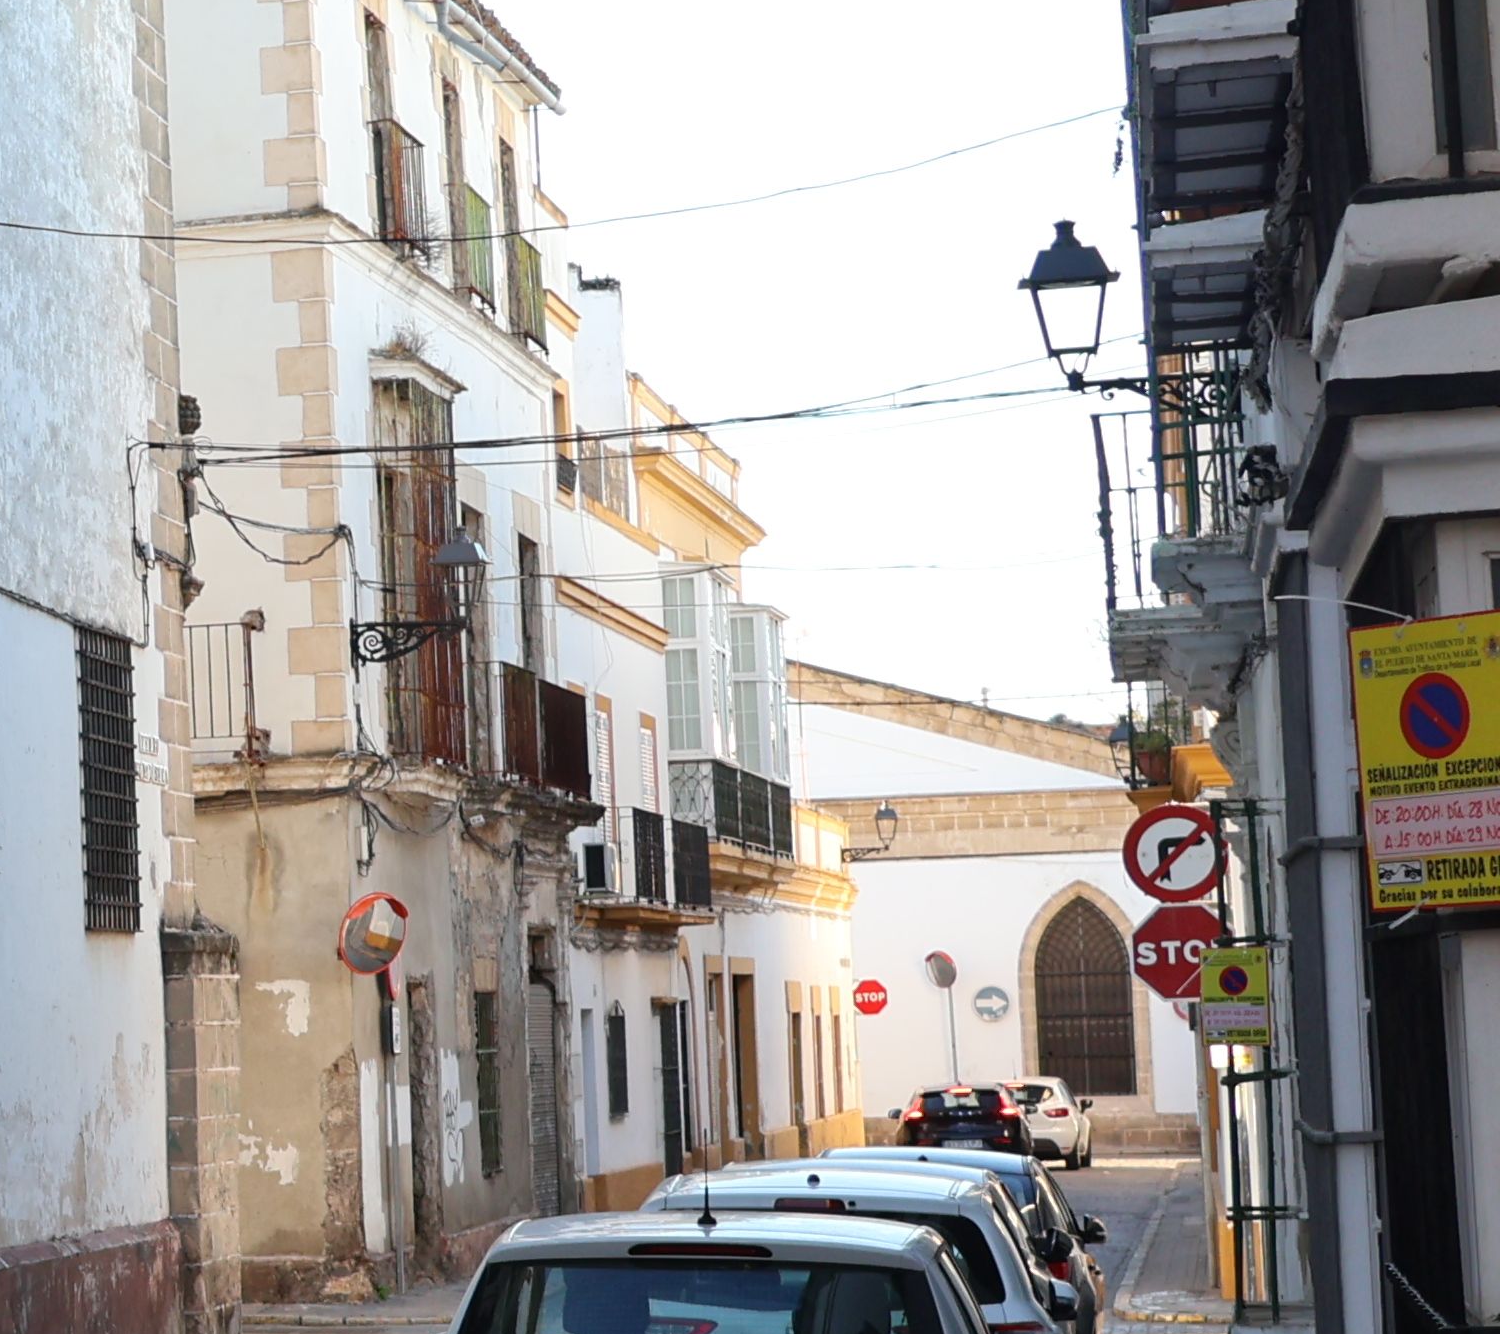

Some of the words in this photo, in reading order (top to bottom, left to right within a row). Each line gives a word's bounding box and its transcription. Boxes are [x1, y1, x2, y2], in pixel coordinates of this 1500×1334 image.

[1467, 635, 1477, 645] DE
[1427, 650, 1451, 662] SANTA
[1367, 759, 1438, 783] SEÑALIZACIÓN
[1370, 784, 1400, 797] MOTIVO
[1404, 782, 1435, 795] EVENTO
[1468, 800, 1484, 819] 28
[1467, 825, 1484, 843] 29
[1426, 856, 1486, 881] RETIRADA
[1379, 887, 1416, 903] Gracias
[1421, 889, 1437, 901] por
[1442, 888, 1454, 899] su
[1136, 939, 1217, 965] STO
[855, 992, 886, 1003] STOP
